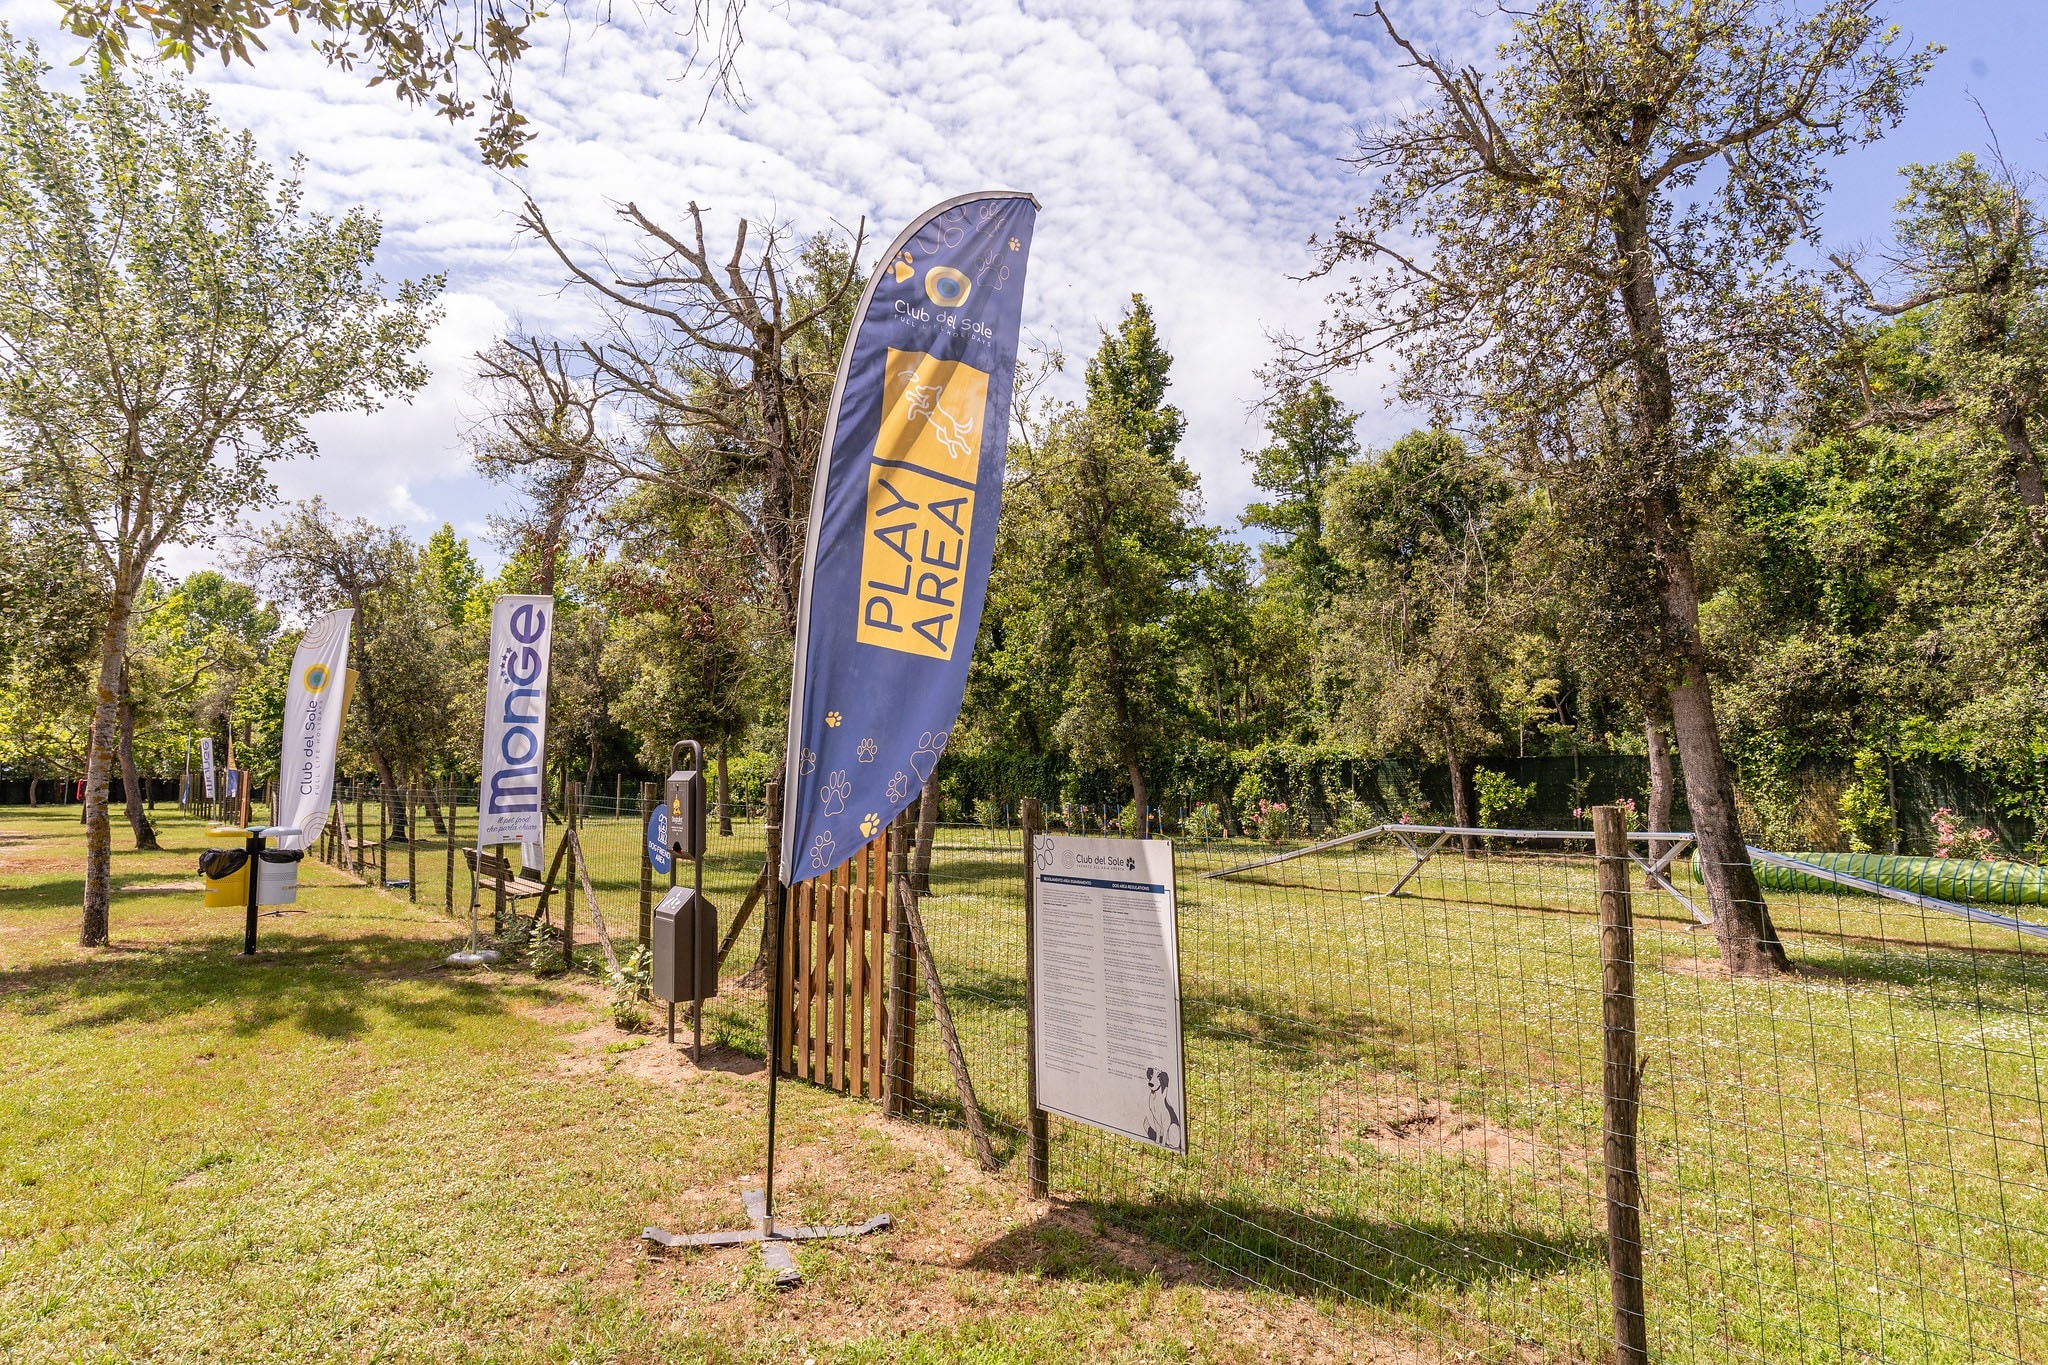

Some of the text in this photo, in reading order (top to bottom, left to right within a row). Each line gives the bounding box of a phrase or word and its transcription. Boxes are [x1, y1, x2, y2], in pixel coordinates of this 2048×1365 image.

[894, 314, 916, 328] FULL
[895, 300, 993, 338] Club del Sole
[865, 478, 919, 633] PLAY
[912, 497, 968, 652] AREA
[300, 700, 318, 796] Club del Sole
[486, 825, 497, 833] che
[497, 824, 517, 833] parla
[503, 816, 514, 825] pet
[515, 815, 531, 825] food
[1076, 853, 1124, 867] Club del Sole
